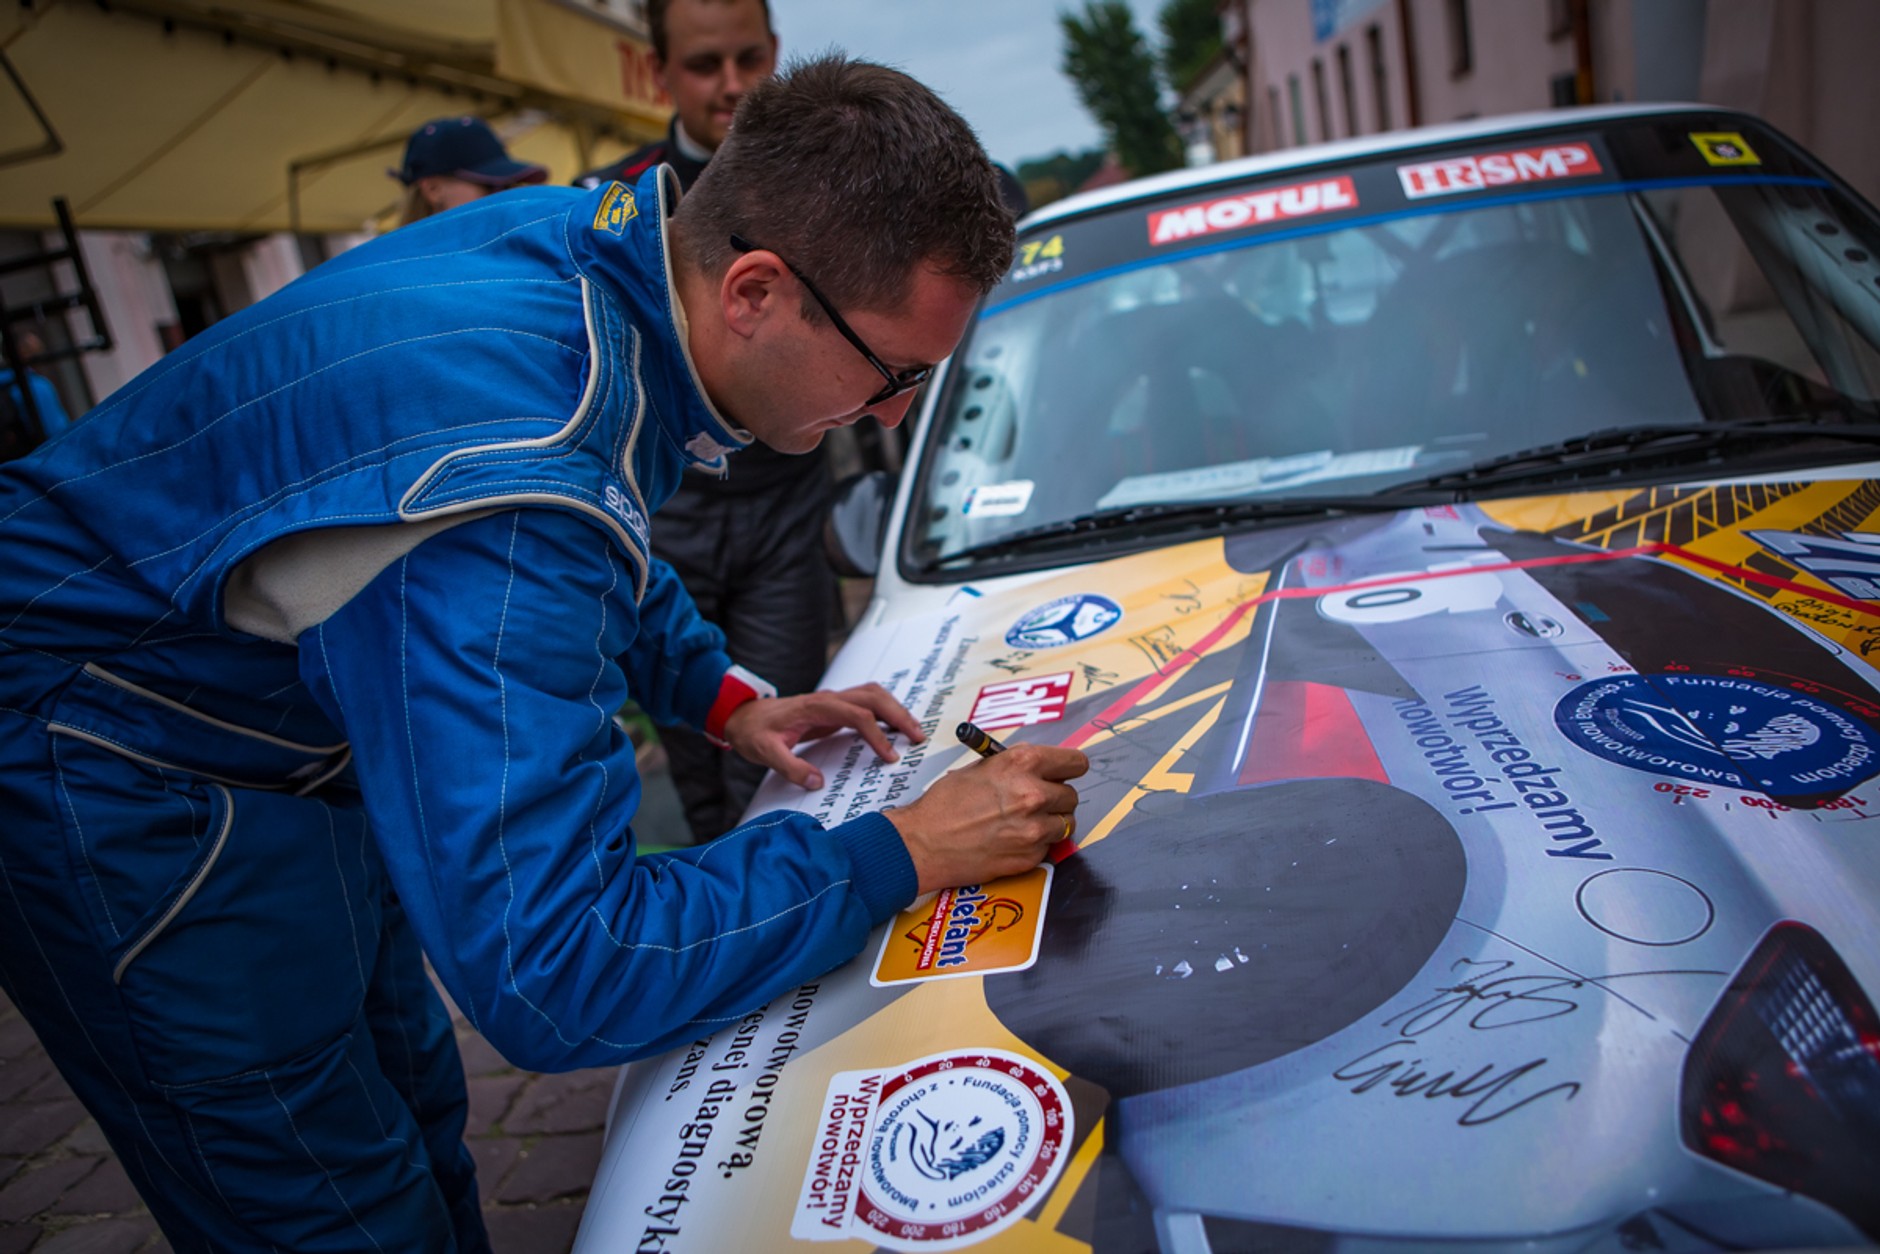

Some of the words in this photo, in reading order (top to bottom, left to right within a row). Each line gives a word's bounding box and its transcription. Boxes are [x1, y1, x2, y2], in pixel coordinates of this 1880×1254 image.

[1404, 146, 1588, 193] HRSMP
[1154, 181, 1350, 243] MOTUL
[1021, 235, 1064, 266] 74
[970, 673, 1070, 730] Fakt
[1665, 676, 1790, 700] Fundacja
[1791, 699, 1867, 742] pomocy
[901, 717, 940, 770] HRMP
[1393, 697, 1518, 815] nowotwór!
[1791, 743, 1875, 783] dzieciom
[1444, 684, 1615, 860] Wyprzedzamy
[711, 1003, 770, 1071] esnej
[665, 1036, 712, 1101] zans.
[717, 983, 820, 1178] nowotworową.
[905, 1074, 913, 1082] 0
[938, 1061, 953, 1071] 20
[975, 1058, 991, 1068] 40
[1009, 1066, 1024, 1078] 60
[929, 1083, 938, 1091] z
[963, 1076, 1021, 1108] Fundacja
[1034, 1084, 1048, 1097] 80
[874, 1088, 926, 1133] chorobą
[1046, 1107, 1059, 1127] 100
[806, 1094, 850, 1209] nowotwór!
[821, 1075, 881, 1229] Wyprzedzamy
[1009, 1108, 1030, 1159] pomocy
[1040, 1139, 1056, 1159] 120
[635, 1080, 738, 1254] diagnostyki
[871, 1136, 919, 1212] nowotworową
[948, 1161, 1015, 1208] dzieciom
[1018, 1173, 1038, 1194] 140
[867, 1209, 889, 1227] 220
[901, 1224, 926, 1236] 200
[942, 1222, 966, 1235] 180
[984, 1205, 1007, 1221] 160
